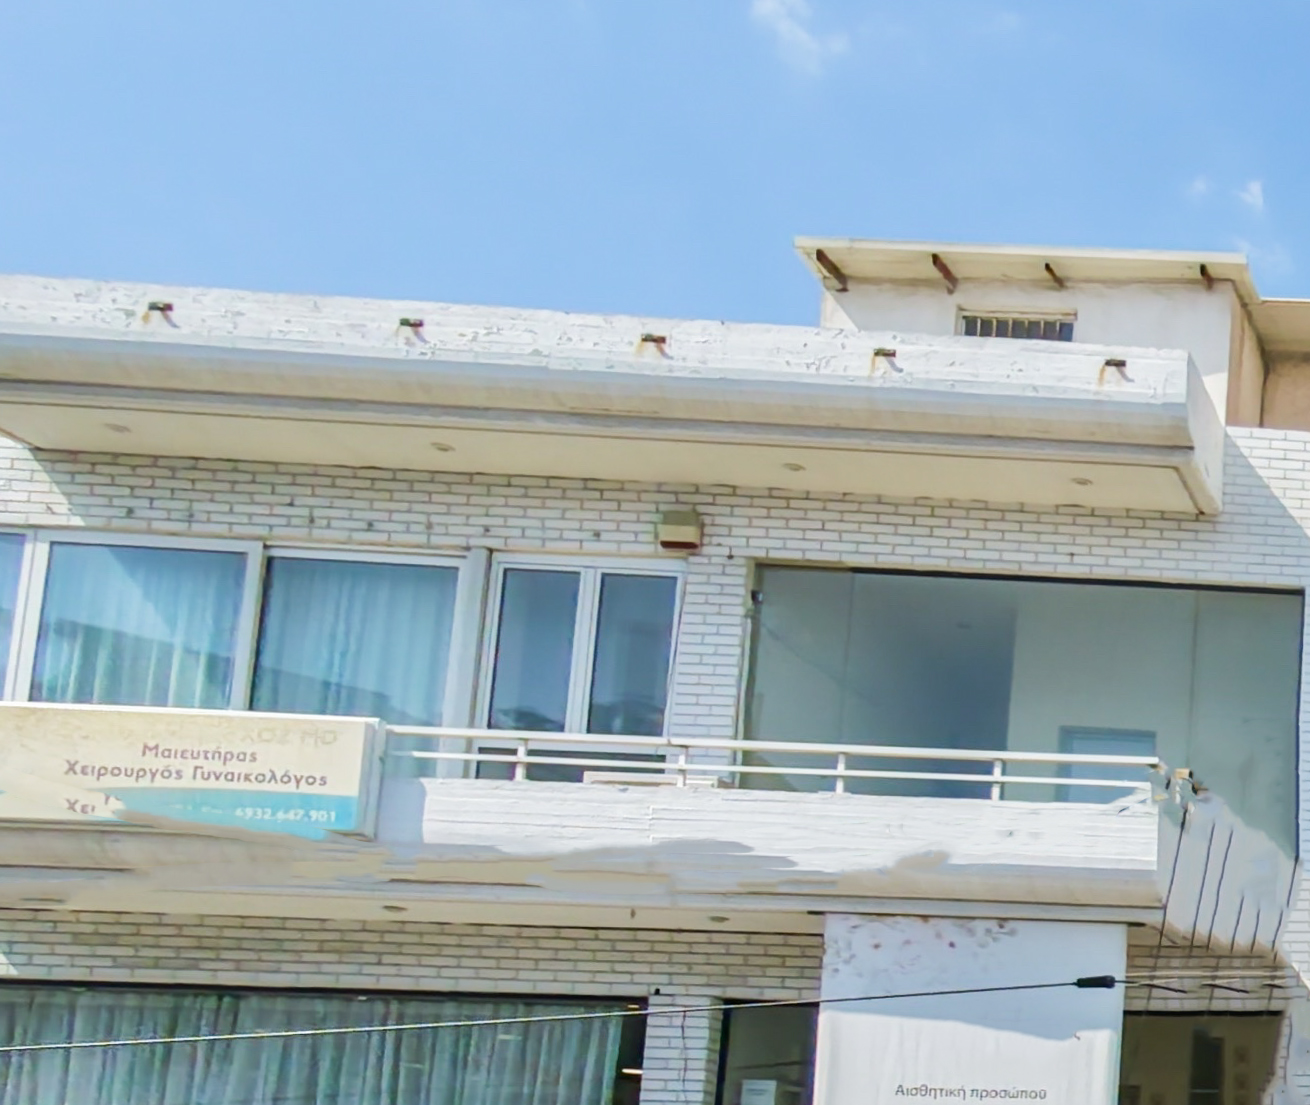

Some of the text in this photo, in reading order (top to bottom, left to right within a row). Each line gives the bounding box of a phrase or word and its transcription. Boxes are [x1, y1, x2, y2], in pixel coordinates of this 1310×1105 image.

[141, 742, 258, 766] Μαιευτήρας
[64, 759, 328, 790] Χειρουργός Γυναικολόγος
[894, 1083, 967, 1102] Αισθητική
